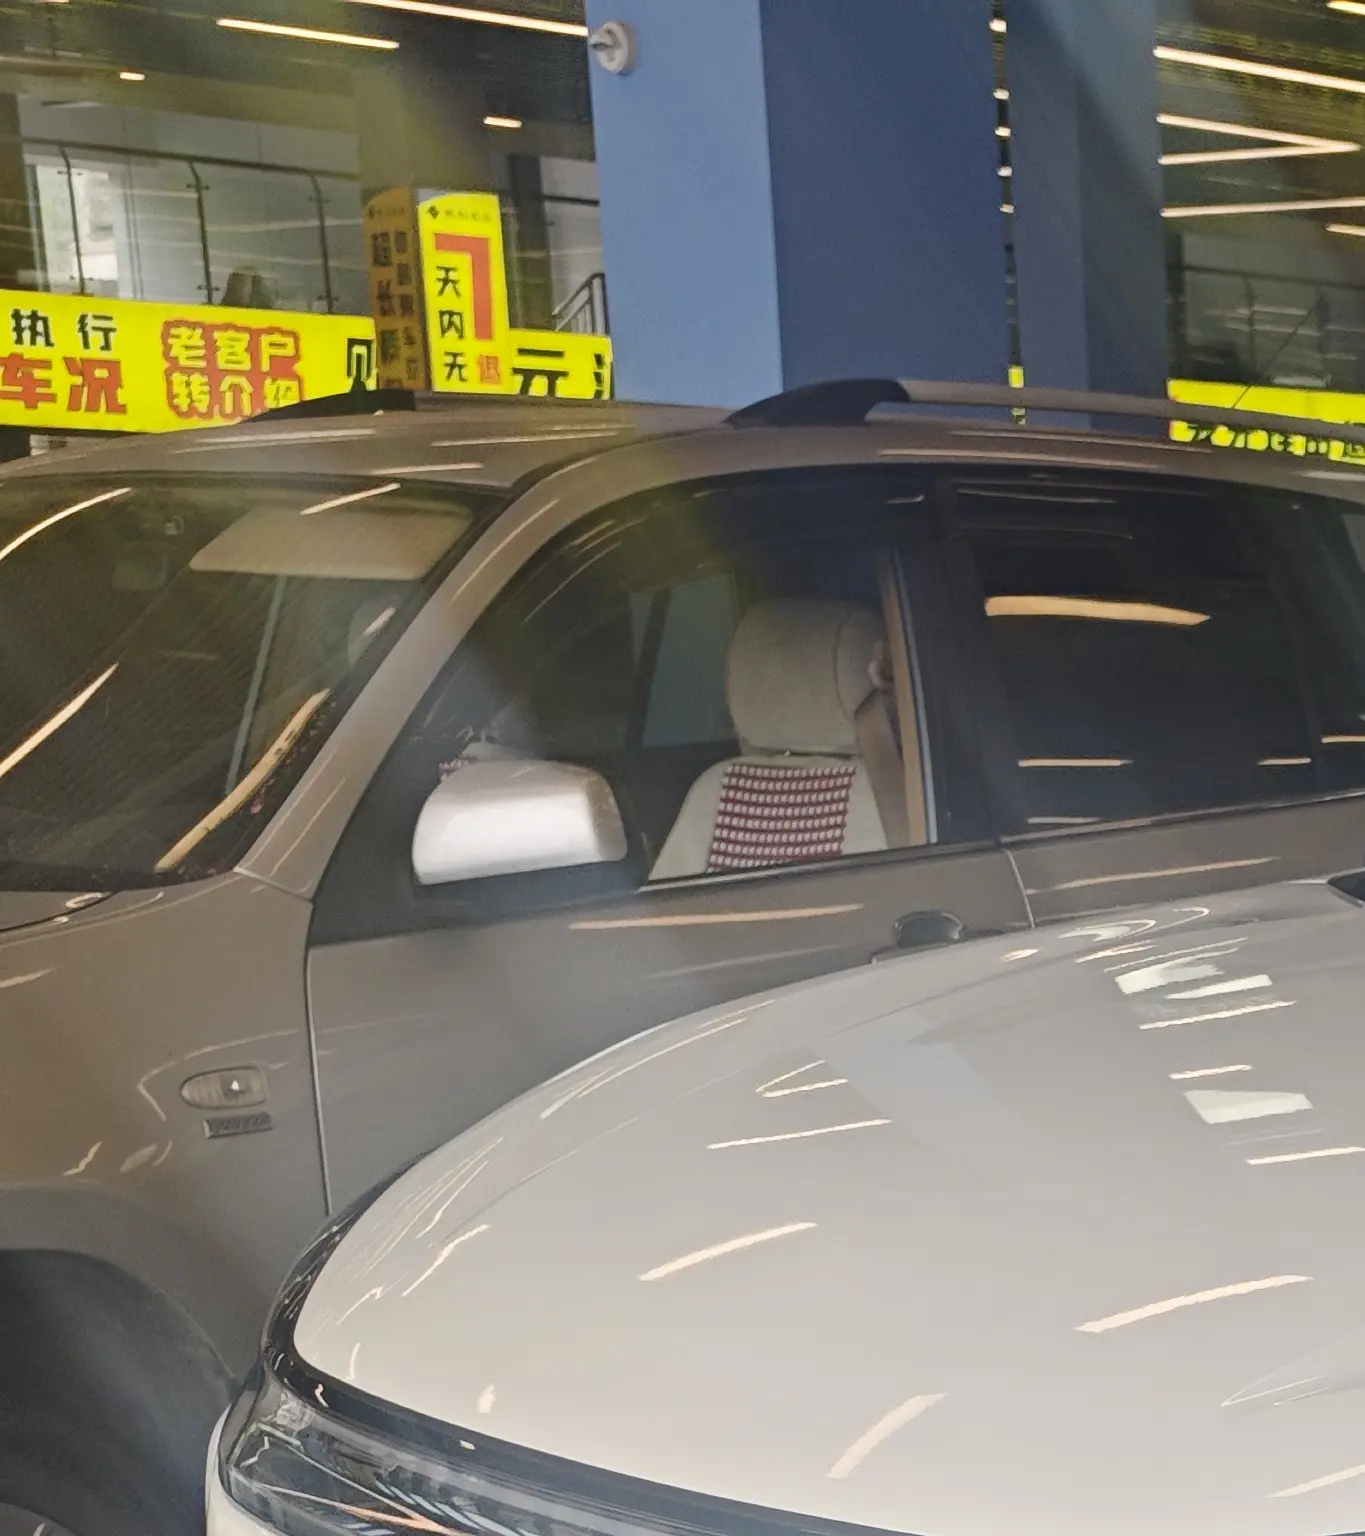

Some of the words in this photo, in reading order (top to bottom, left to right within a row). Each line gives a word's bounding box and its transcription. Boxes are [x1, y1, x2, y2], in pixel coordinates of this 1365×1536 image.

[10, 308, 117, 350] 执行
[435, 265, 468, 382] 天内无
[168, 326, 296, 373] 老客户
[0, 353, 128, 414] 车况
[170, 372, 301, 417] 转介绍
